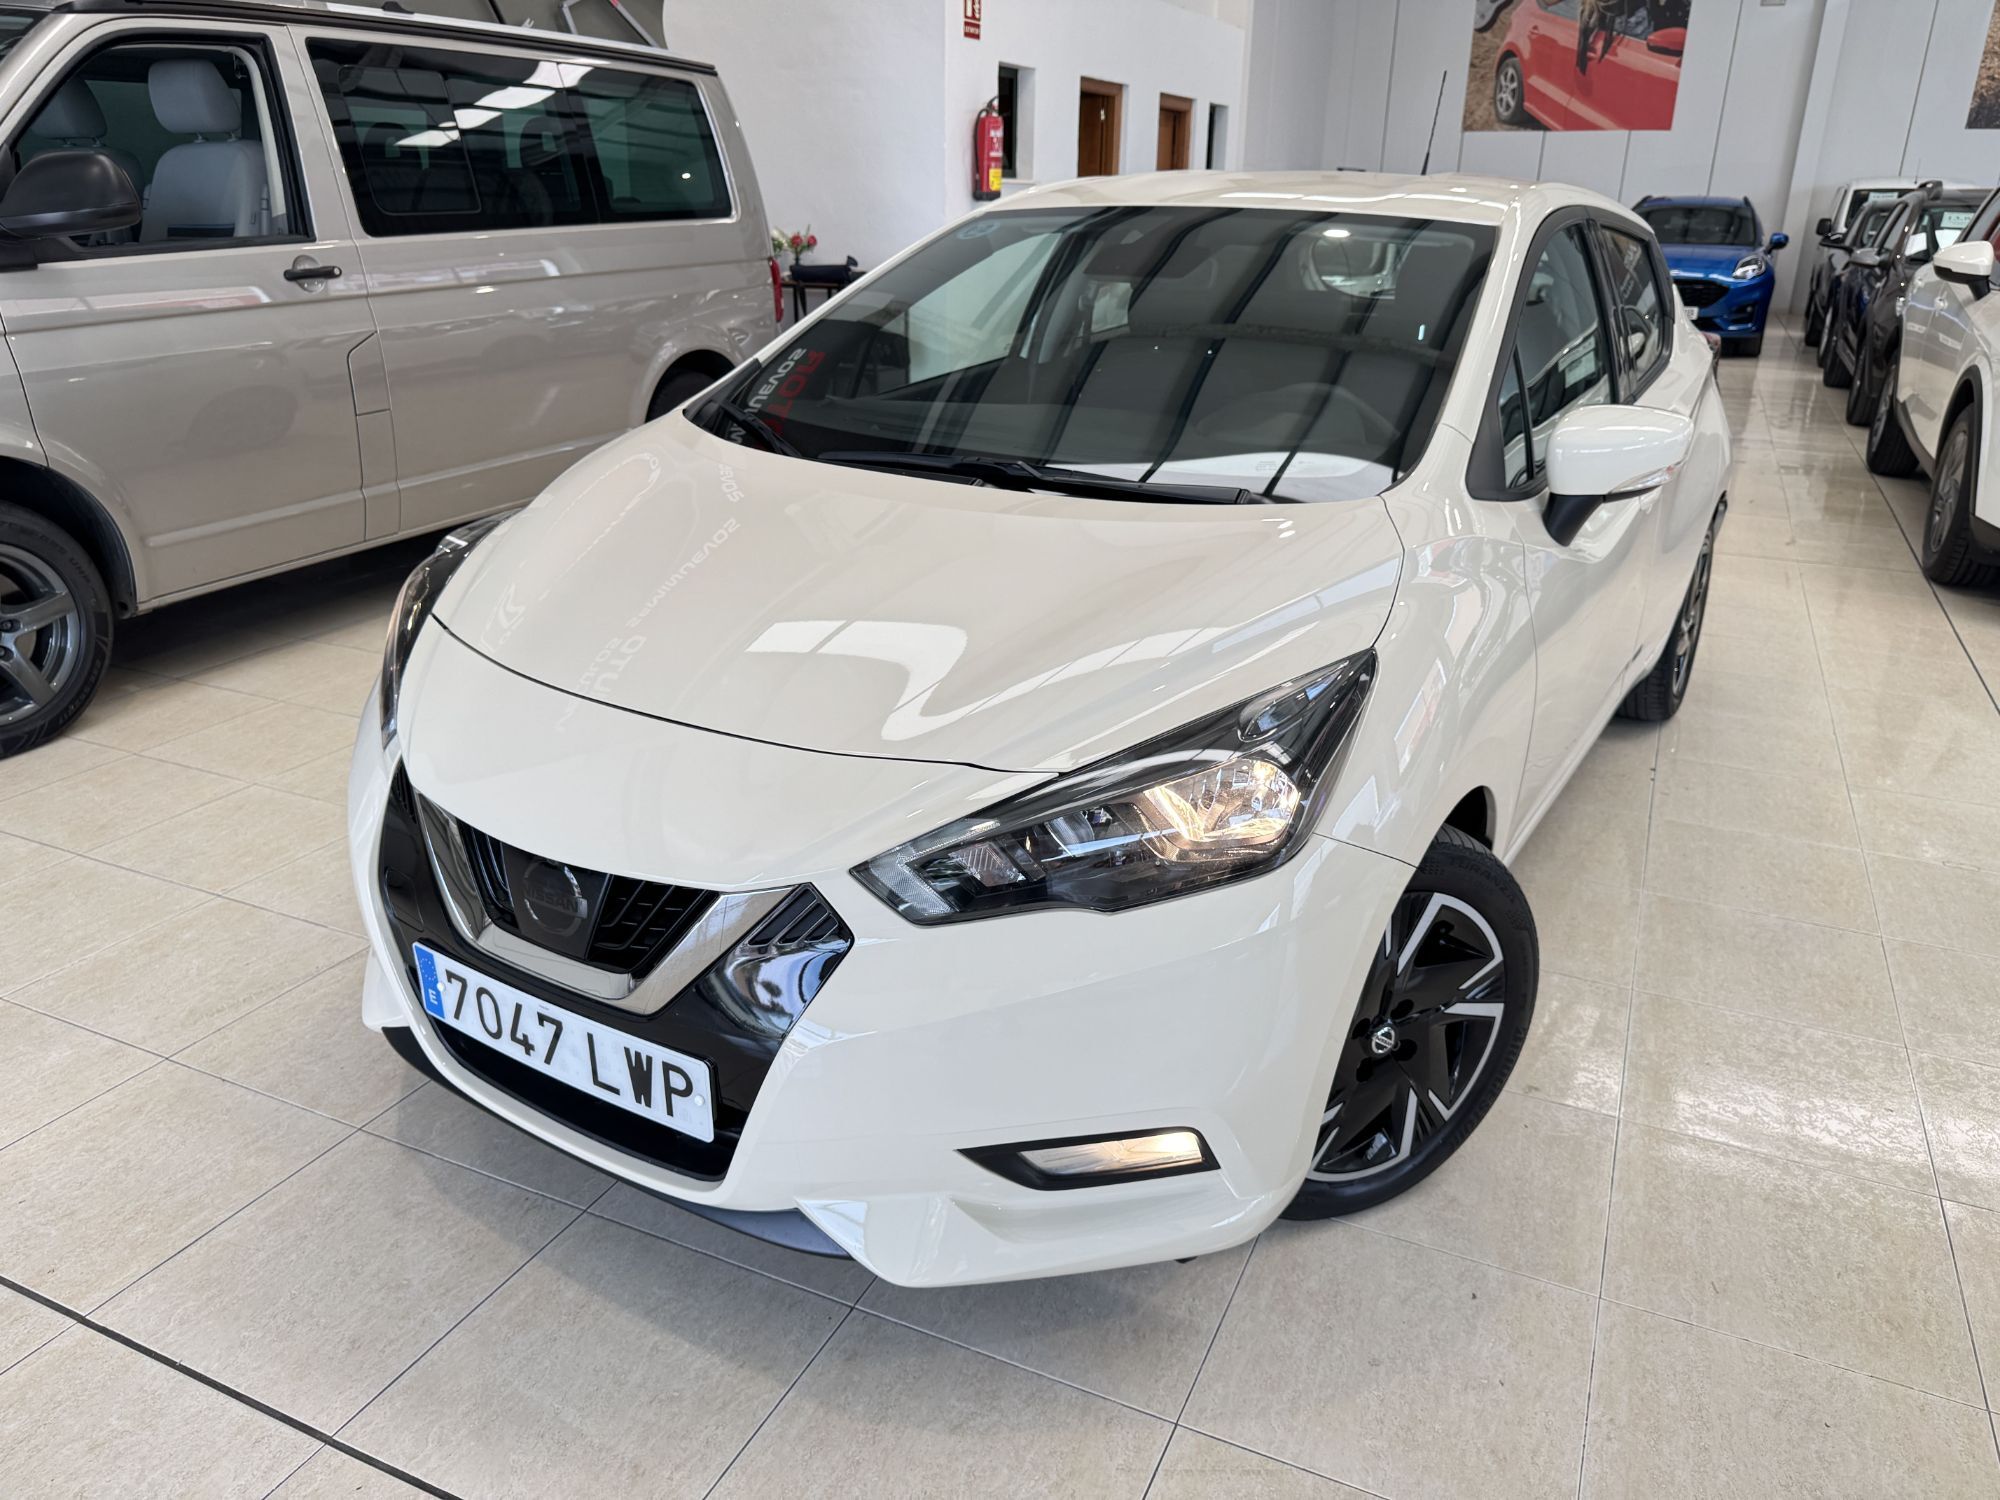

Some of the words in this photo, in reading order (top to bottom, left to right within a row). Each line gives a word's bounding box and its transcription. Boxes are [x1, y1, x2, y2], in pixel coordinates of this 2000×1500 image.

[521, 880, 577, 913] NISSAN
[428, 989, 438, 1005] E
[445, 969, 563, 1066] 7047
[587, 1032, 694, 1118] LWP
